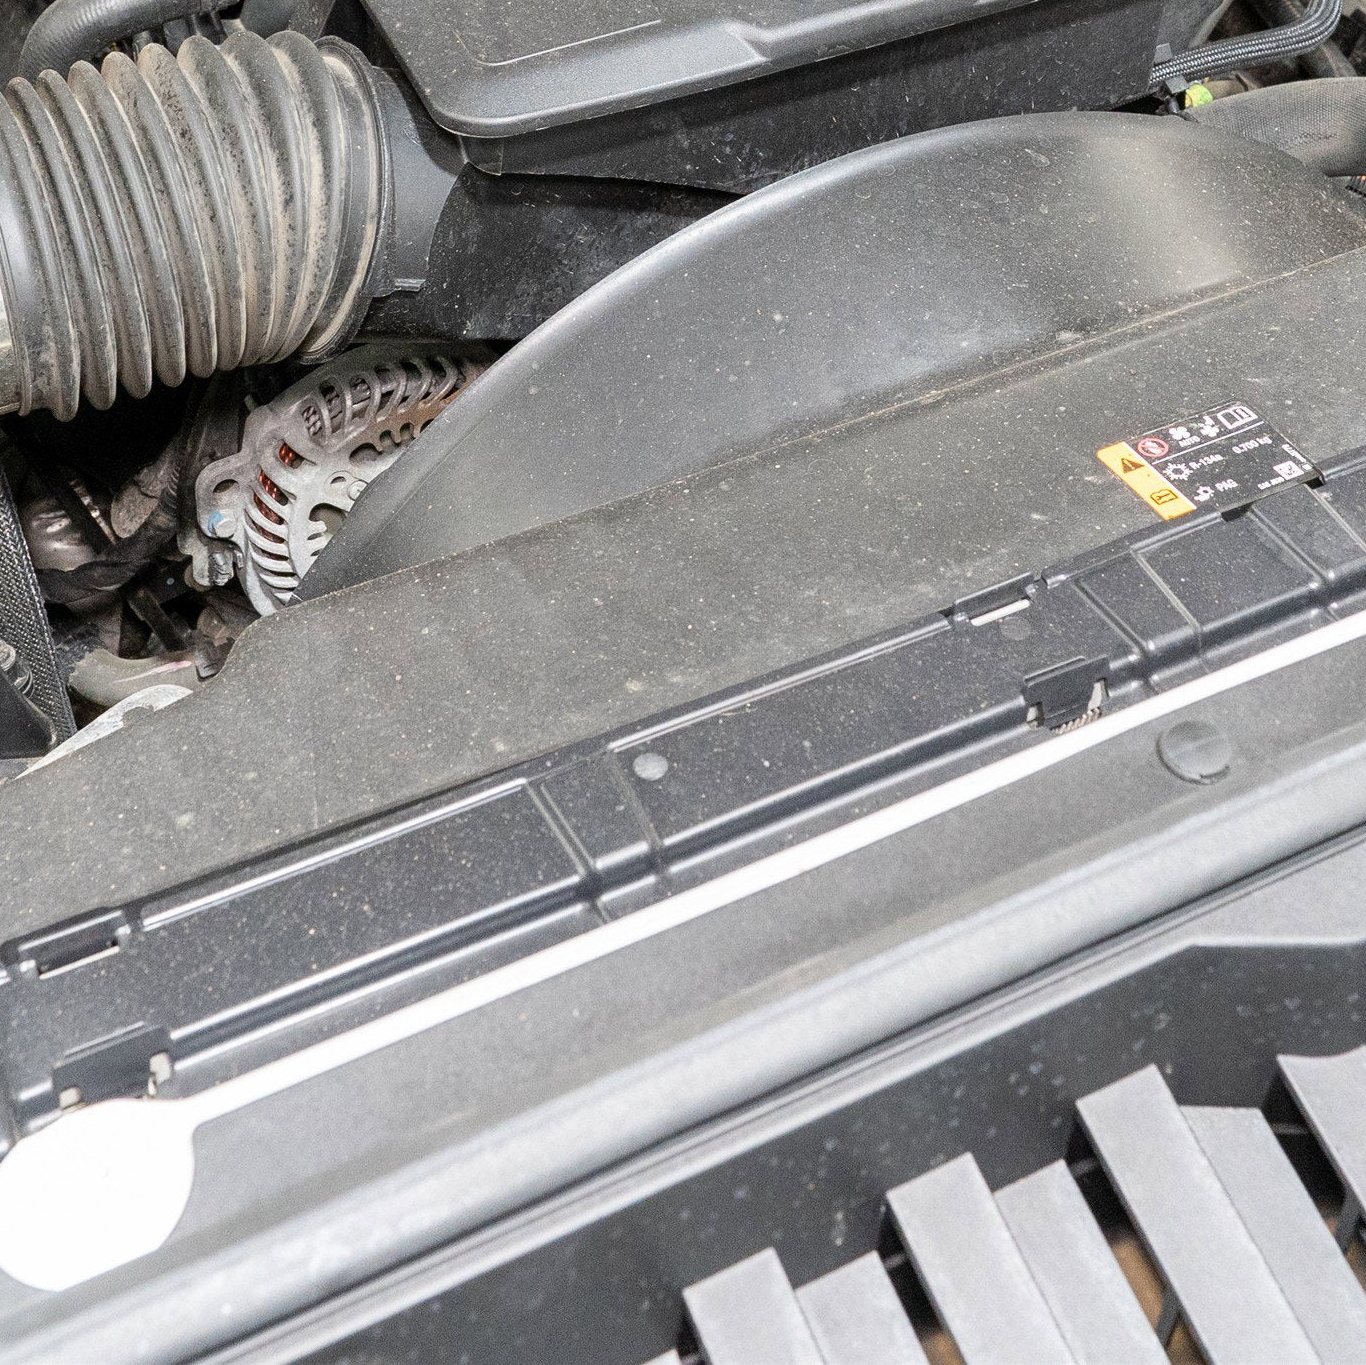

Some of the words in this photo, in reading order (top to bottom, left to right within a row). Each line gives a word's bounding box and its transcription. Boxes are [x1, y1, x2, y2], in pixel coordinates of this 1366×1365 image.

[1178, 436, 1201, 448] AUTO
[1188, 454, 1224, 471] R-134a
[1231, 440, 1260, 455] 0.700
[1255, 435, 1273, 446] kg
[1214, 479, 1239, 492] PAG
